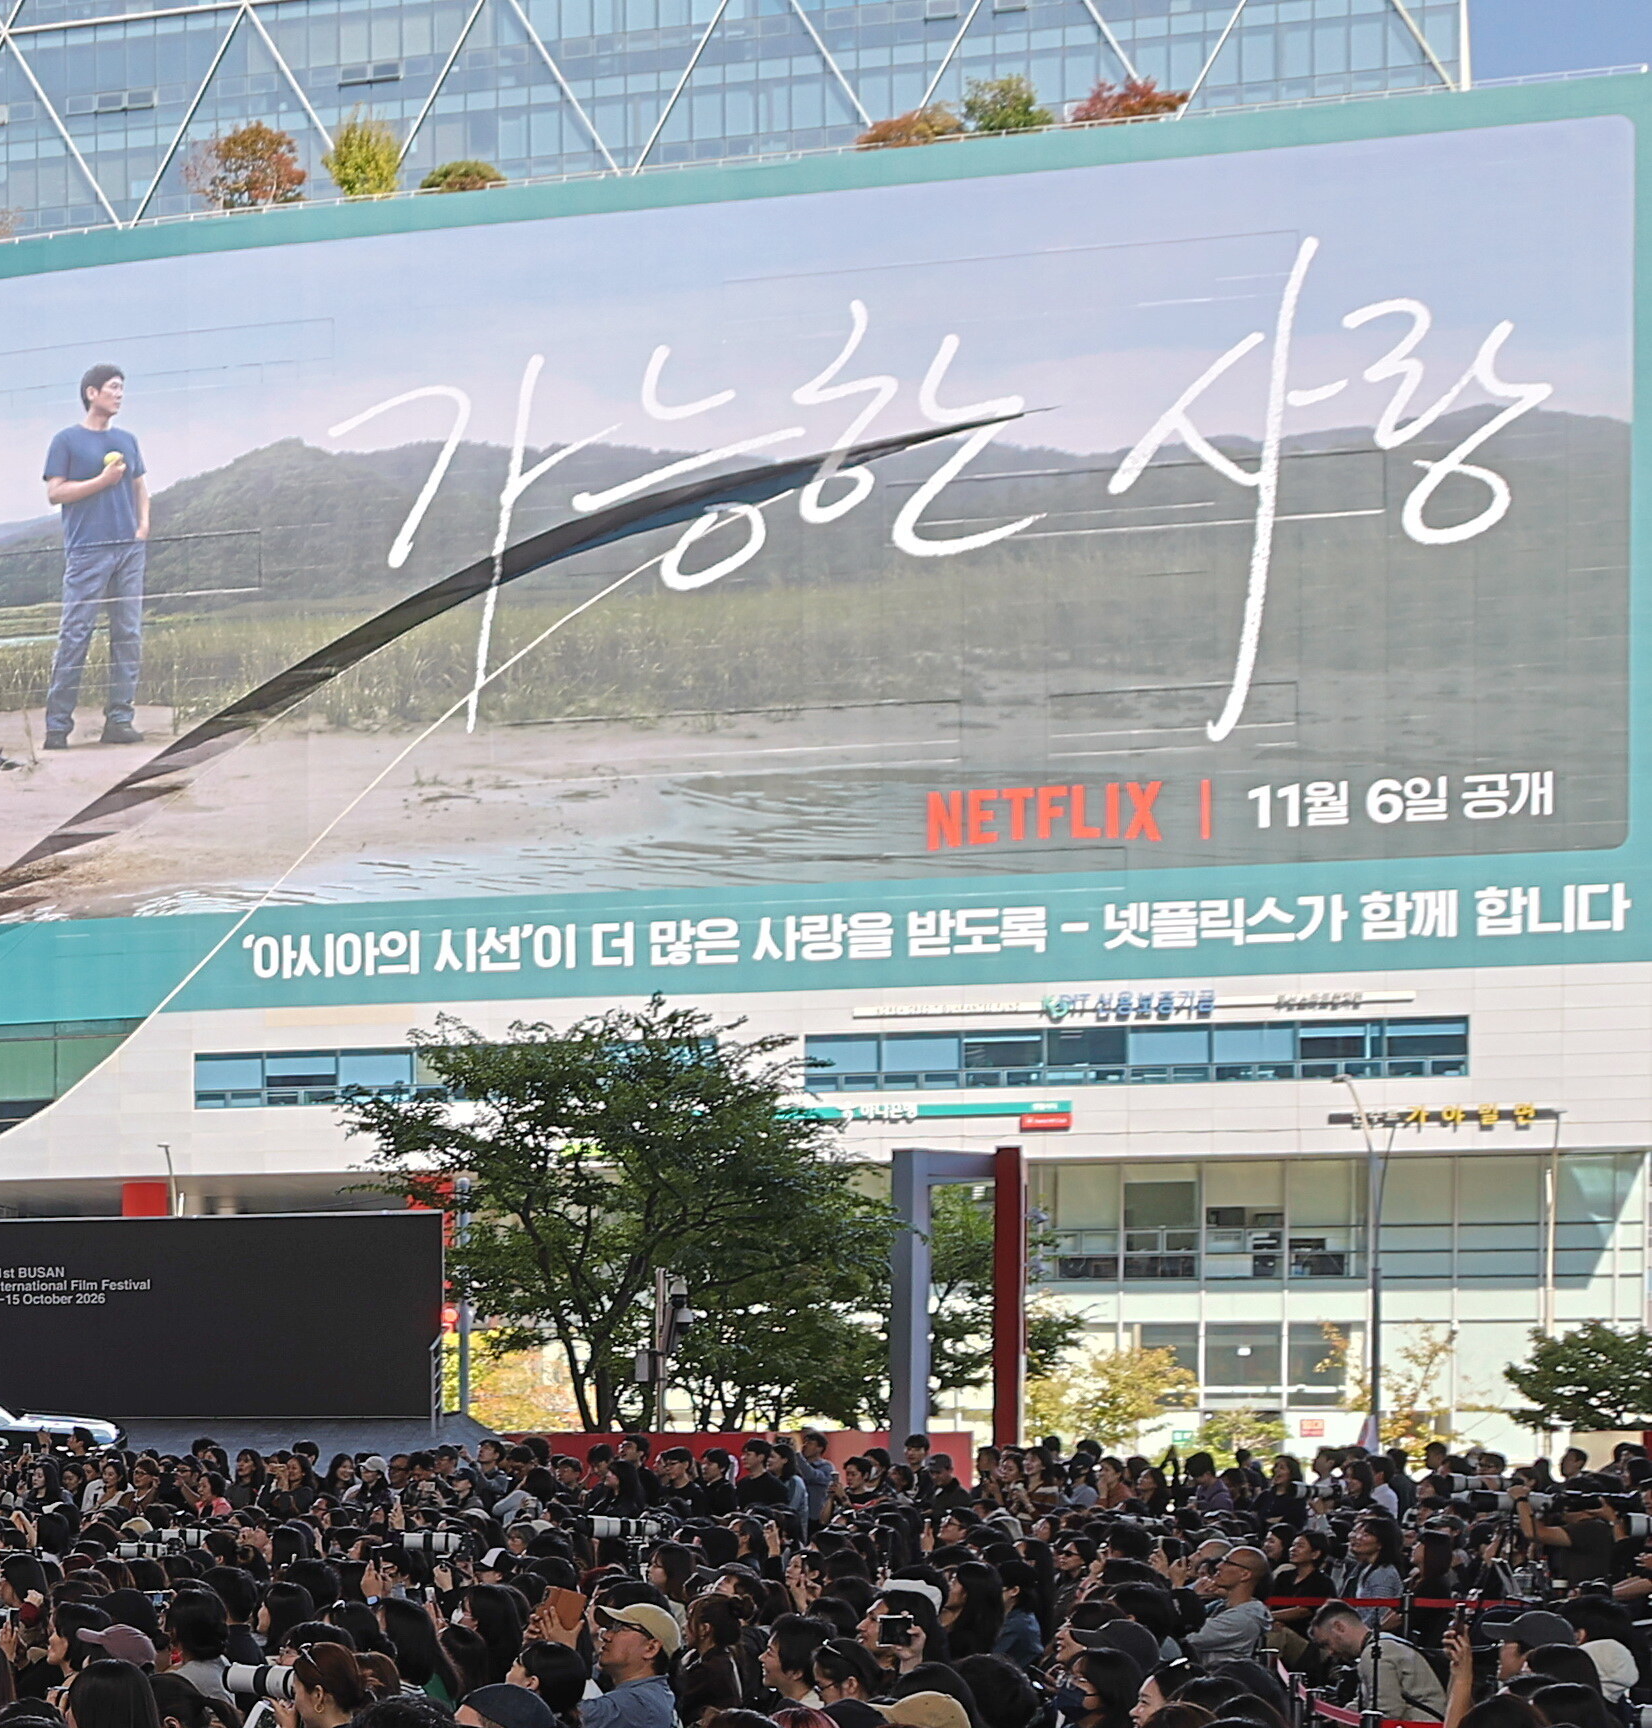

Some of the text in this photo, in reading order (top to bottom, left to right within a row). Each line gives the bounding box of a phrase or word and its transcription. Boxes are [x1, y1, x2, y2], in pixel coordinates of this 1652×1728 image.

[329, 236, 1554, 741] 가능한 사랑
[926, 780, 1163, 851] NETFLIX
[1246, 770, 1554, 828] 11월 6일 공개
[591, 920, 634, 968] 더
[649, 916, 740, 967] 많은
[752, 910, 894, 962] 사랑을
[907, 905, 1048, 958] 받도록
[1102, 894, 1349, 950] 넷플릭스가
[1360, 888, 1459, 939] 함께
[1474, 880, 1631, 937] 합니다
[17, 1266, 65, 1278] BUSAN
[22, 1293, 73, 1305] October
[75, 1292, 106, 1304] 2026
[70, 1279, 97, 1291] Film
[101, 1278, 151, 1291] Festival
